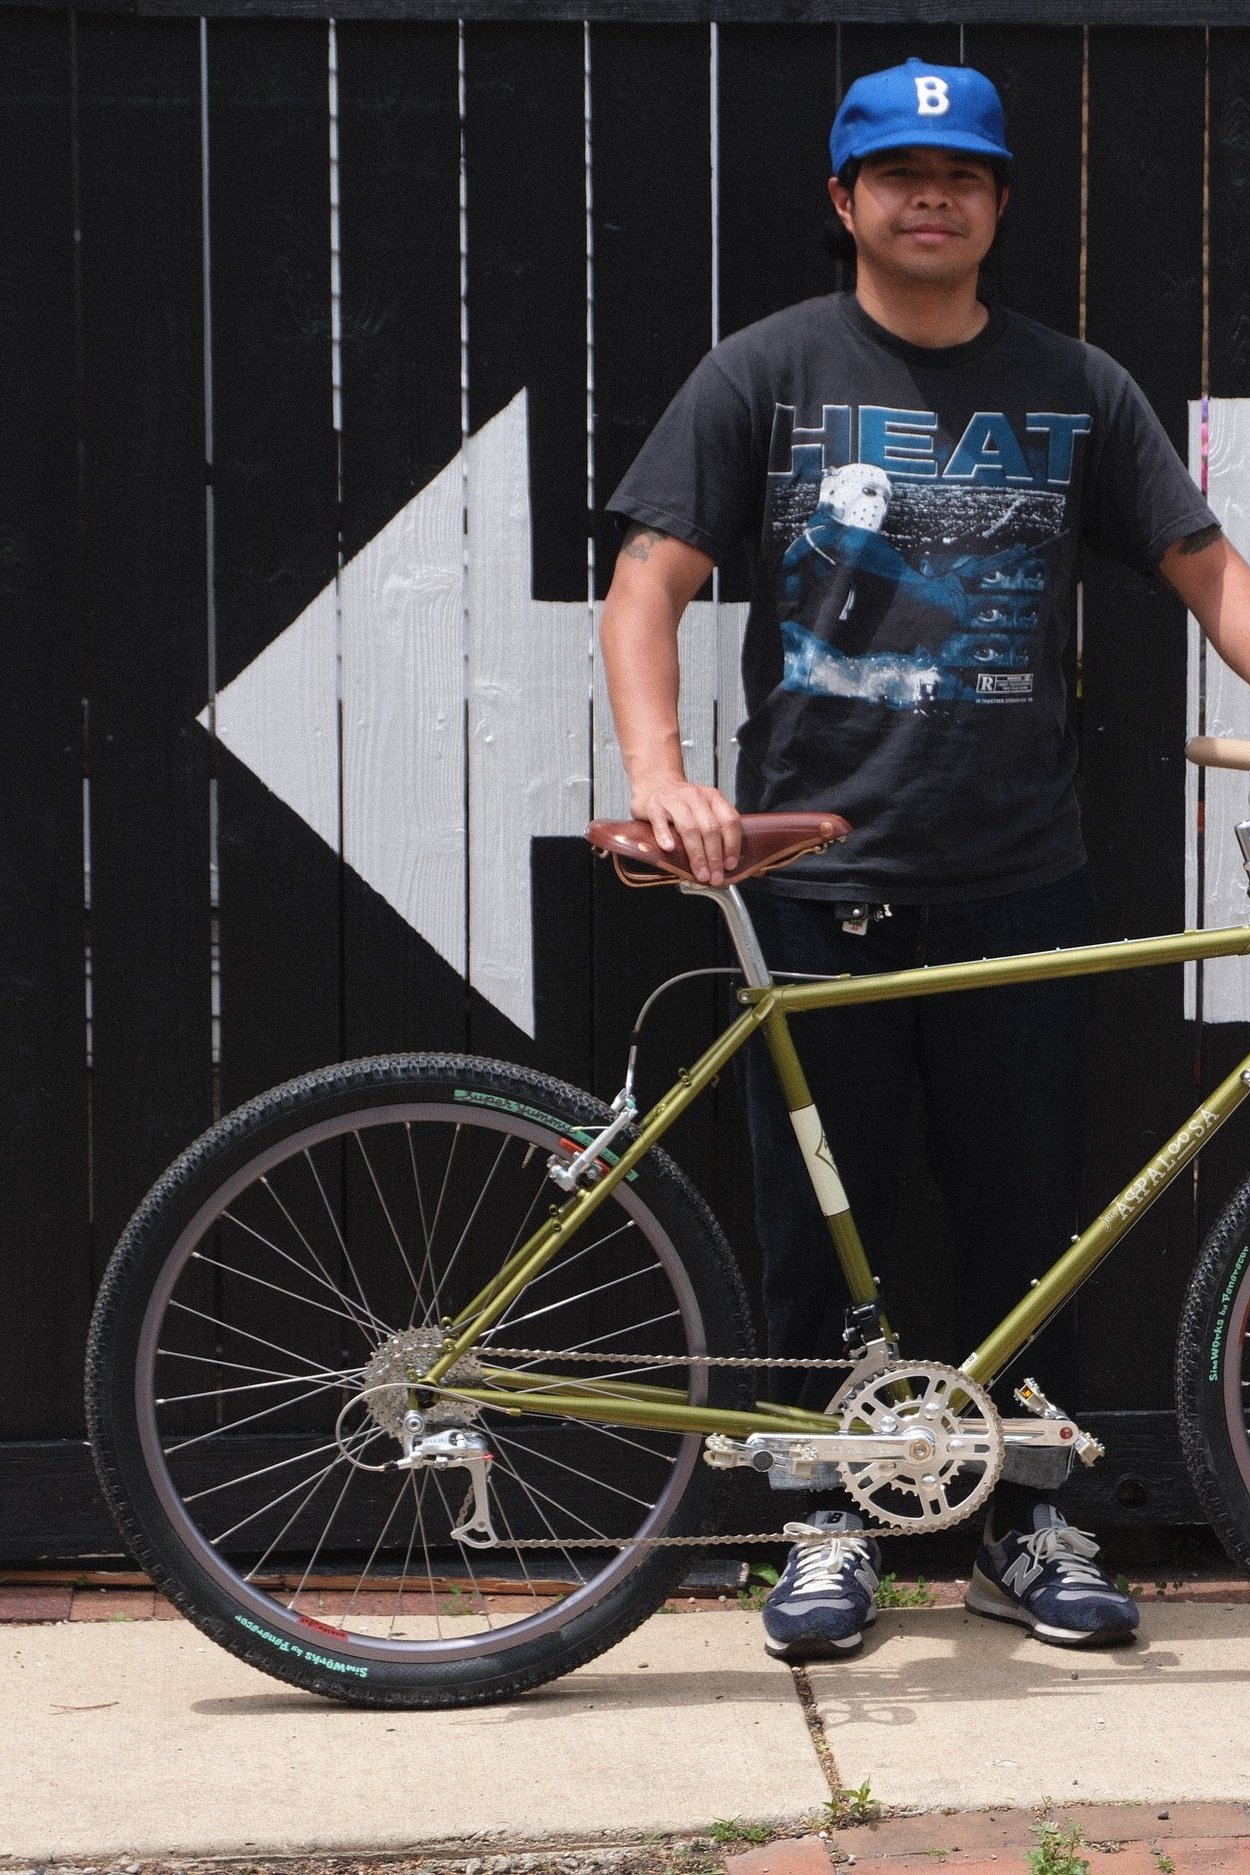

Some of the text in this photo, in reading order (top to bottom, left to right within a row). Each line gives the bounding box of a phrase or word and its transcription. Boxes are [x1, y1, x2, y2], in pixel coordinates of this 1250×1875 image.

[915, 76, 950, 116] B
[767, 402, 1093, 484] HEAT
[981, 675, 995, 691] R
[1116, 1109, 1220, 1221] APPALOOSA
[1222, 1246, 1249, 1303] Panaracer
[1001, 1552, 1044, 1597] N
[234, 1615, 291, 1652] Panaracer
